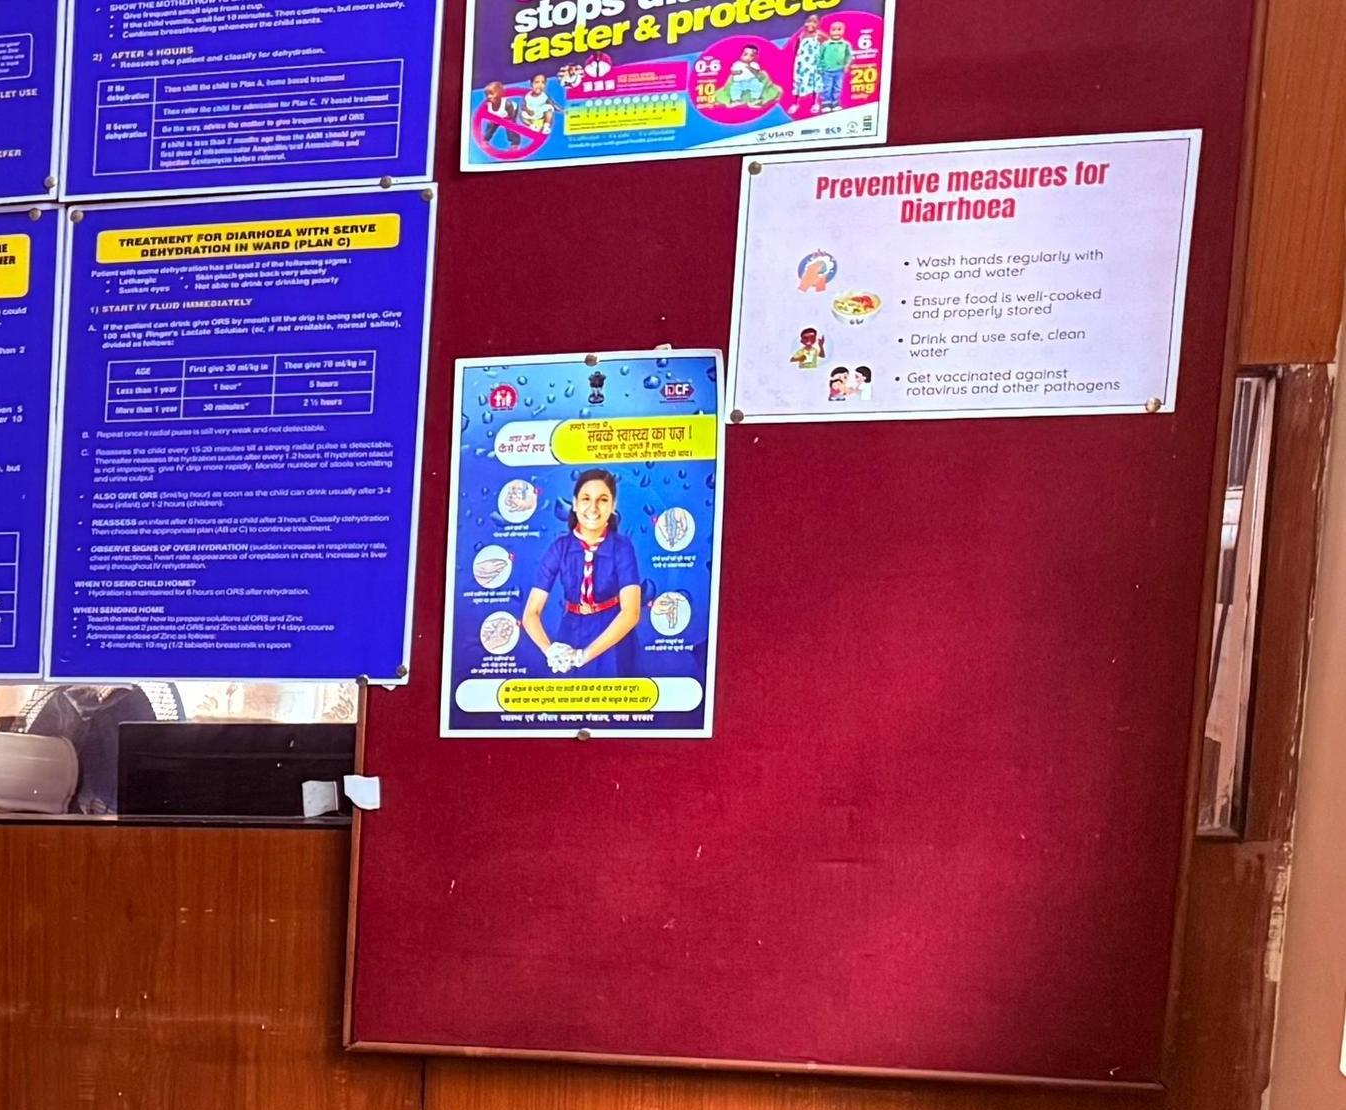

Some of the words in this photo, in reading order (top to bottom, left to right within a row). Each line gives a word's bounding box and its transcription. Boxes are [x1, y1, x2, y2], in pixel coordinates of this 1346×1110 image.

[515, 0, 625, 33] stops
[511, 20, 630, 64] faster
[634, 15, 661, 41] &
[668, 0, 840, 43] protects
[858, 35, 872, 49] 6
[695, 60, 721, 73] 0-6
[852, 68, 877, 83] 20
[697, 84, 715, 95] 10
[769, 130, 794, 139] USAID
[816, 170, 939, 200] Preventive
[947, 165, 1067, 192] measures
[1075, 161, 1109, 186] for
[901, 196, 1016, 223] Diarrhoea
[119, 234, 191, 247] TREATMENT
[196, 231, 222, 242] FOR
[226, 228, 292, 240] DIARHOEA
[297, 226, 329, 237] WITH
[333, 223, 376, 235] SERVE
[140, 244, 230, 258] DEHYDRATION
[235, 243, 248, 253] IN
[253, 240, 289, 251] WARD
[294, 238, 333, 251] (PLAN
[337, 236, 351, 248] C)
[916, 256, 956, 268] Wash
[960, 254, 1003, 266] hands
[1007, 251, 1070, 266] regularly
[1075, 249, 1103, 261] with
[916, 269, 949, 281] soap
[954, 267, 980, 279] and
[986, 266, 1026, 277] water
[913, 294, 960, 307] Ensure
[966, 292, 998, 304] food
[1002, 292, 1012, 303] is
[1016, 288, 1102, 302] well-cooked
[912, 307, 939, 319] and
[943, 305, 1002, 320] properly
[1007, 303, 1052, 316] stored
[910, 332, 946, 345] Drink
[951, 331, 977, 343] and
[982, 332, 1006, 342] use
[1010, 329, 1044, 342] safe,
[1047, 329, 1086, 340] clean
[909, 347, 949, 358] water
[907, 371, 931, 383] Get
[935, 369, 1011, 383] vaccinated
[1016, 368, 1068, 382] against
[907, 384, 967, 396] rotavirus
[971, 383, 998, 394] and
[1002, 381, 1039, 393] other
[1044, 380, 1120, 395] pathogens
